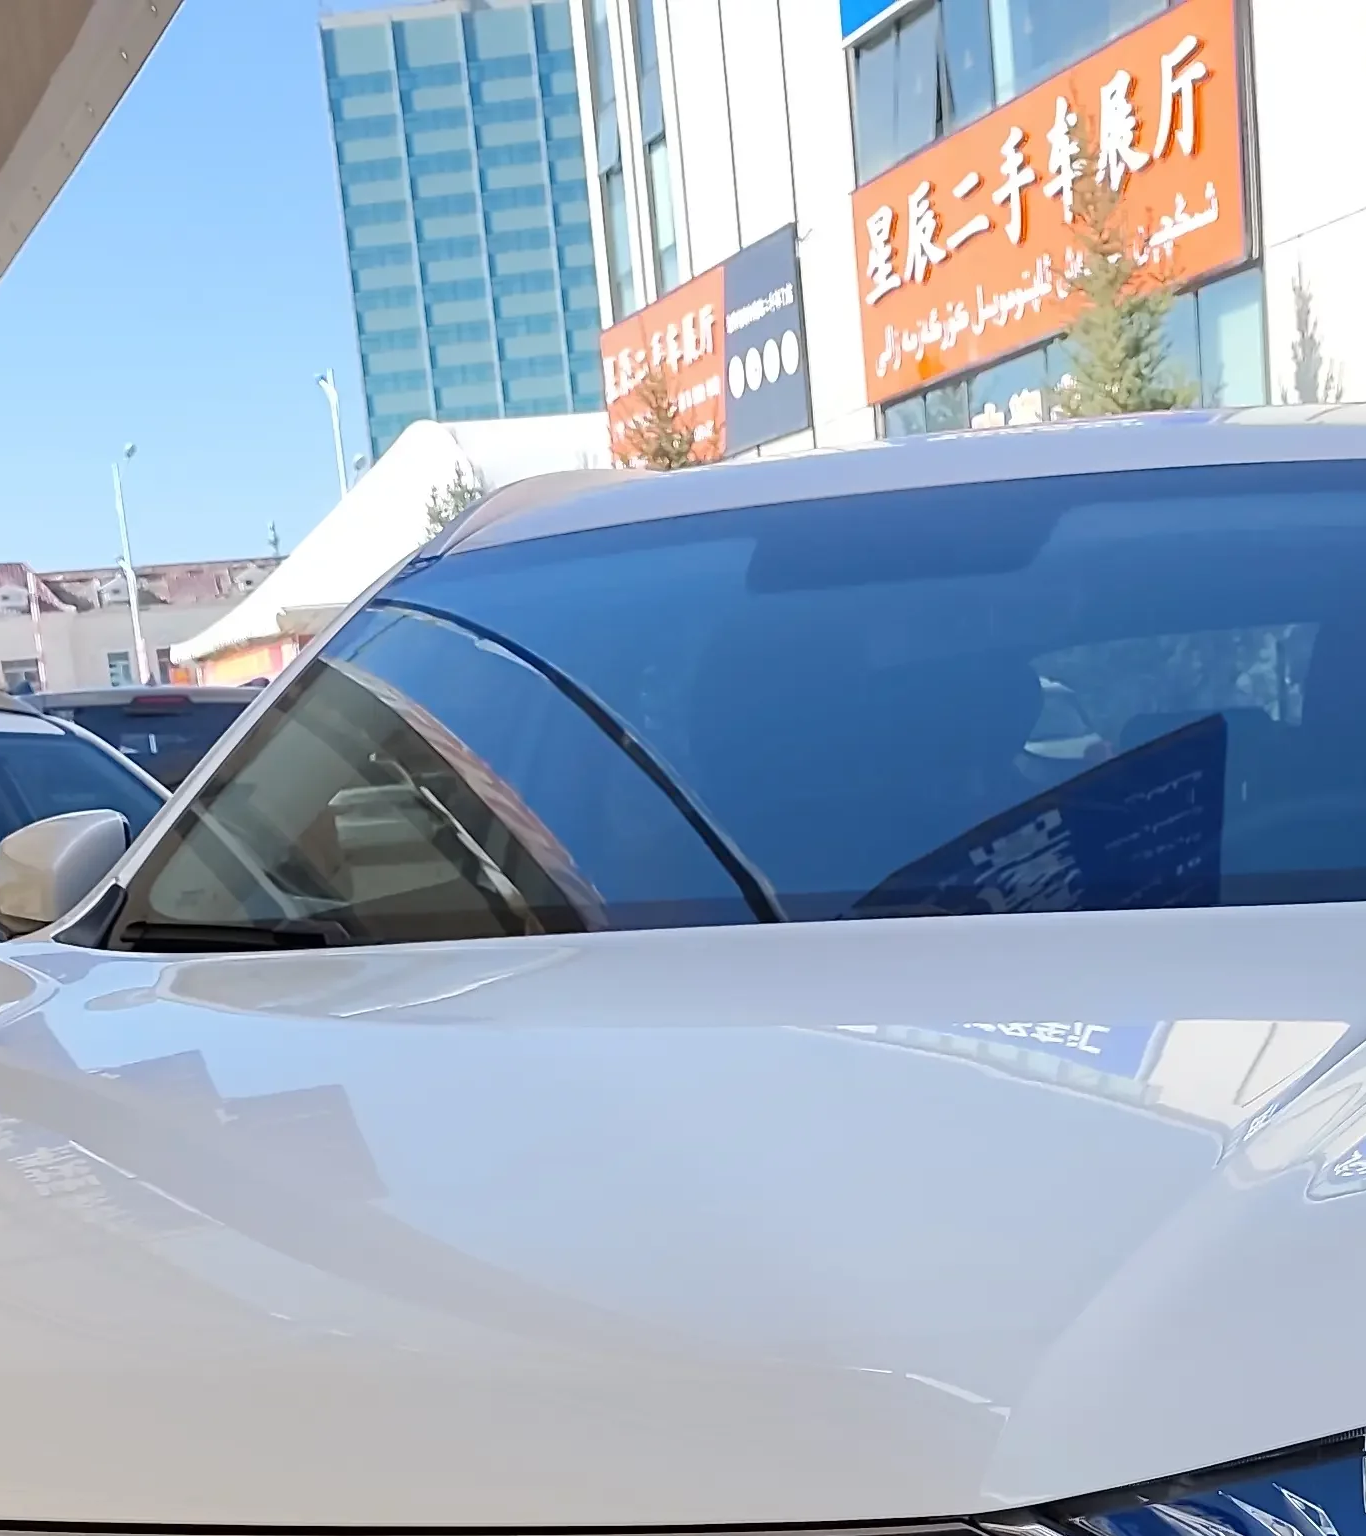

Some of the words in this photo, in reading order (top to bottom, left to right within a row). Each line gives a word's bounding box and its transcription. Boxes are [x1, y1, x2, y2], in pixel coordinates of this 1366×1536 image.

[865, 35, 1208, 305] 星辰二手车展厅
